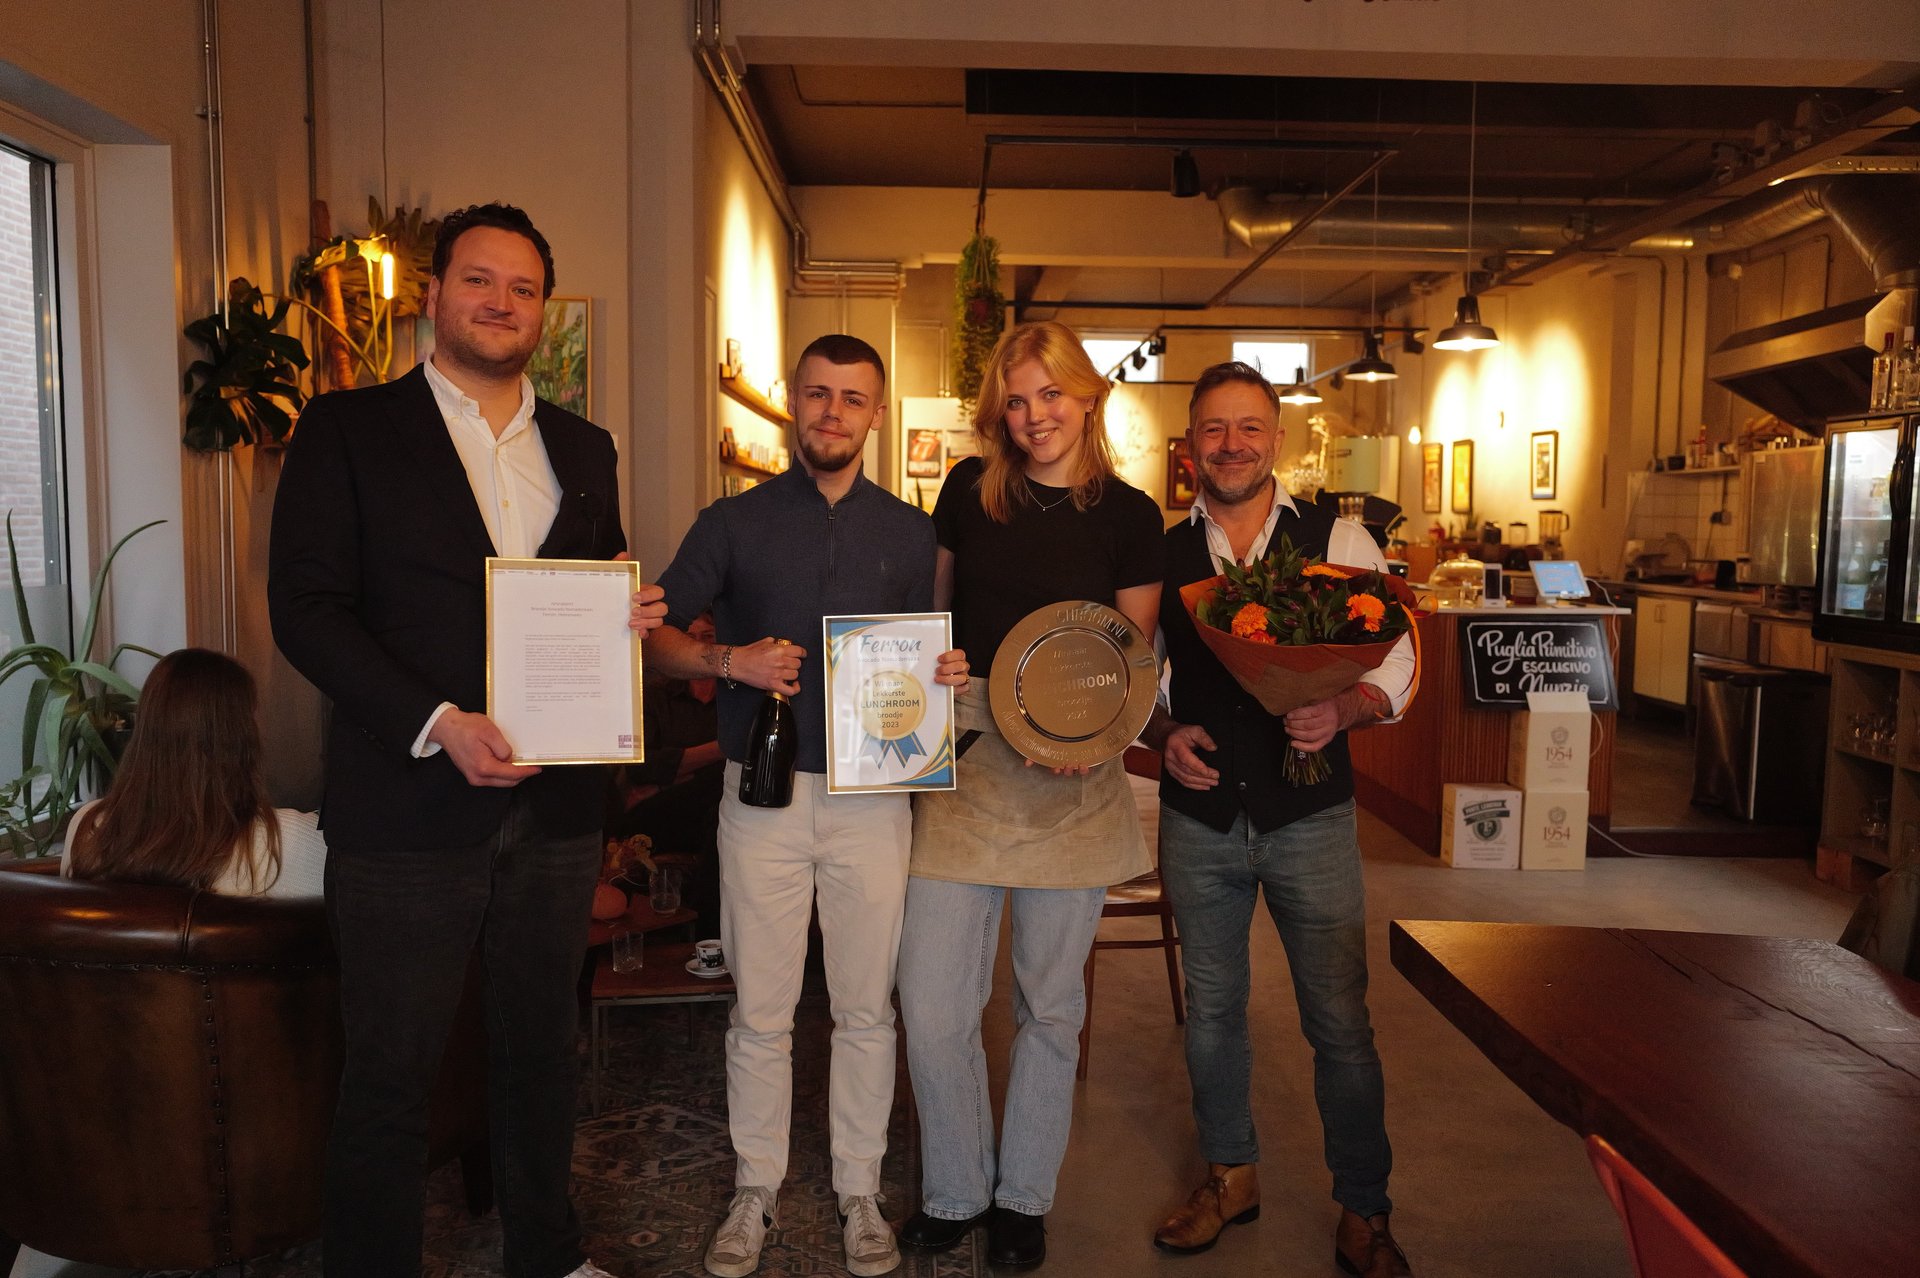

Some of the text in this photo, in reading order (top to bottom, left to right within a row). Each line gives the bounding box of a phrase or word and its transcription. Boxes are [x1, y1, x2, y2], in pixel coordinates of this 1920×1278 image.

[860, 634, 922, 653] Ferron
[1477, 630, 1597, 675] Puglia Primitivo
[1522, 661, 1591, 674] ESCLUSIVO
[874, 679, 904, 687] Winaar
[1495, 682, 1510, 694] DI
[877, 711, 904, 720] broodje
[881, 721, 900, 729] 2023
[1545, 747, 1573, 761] 1954
[1543, 826, 1571, 841] 1954
